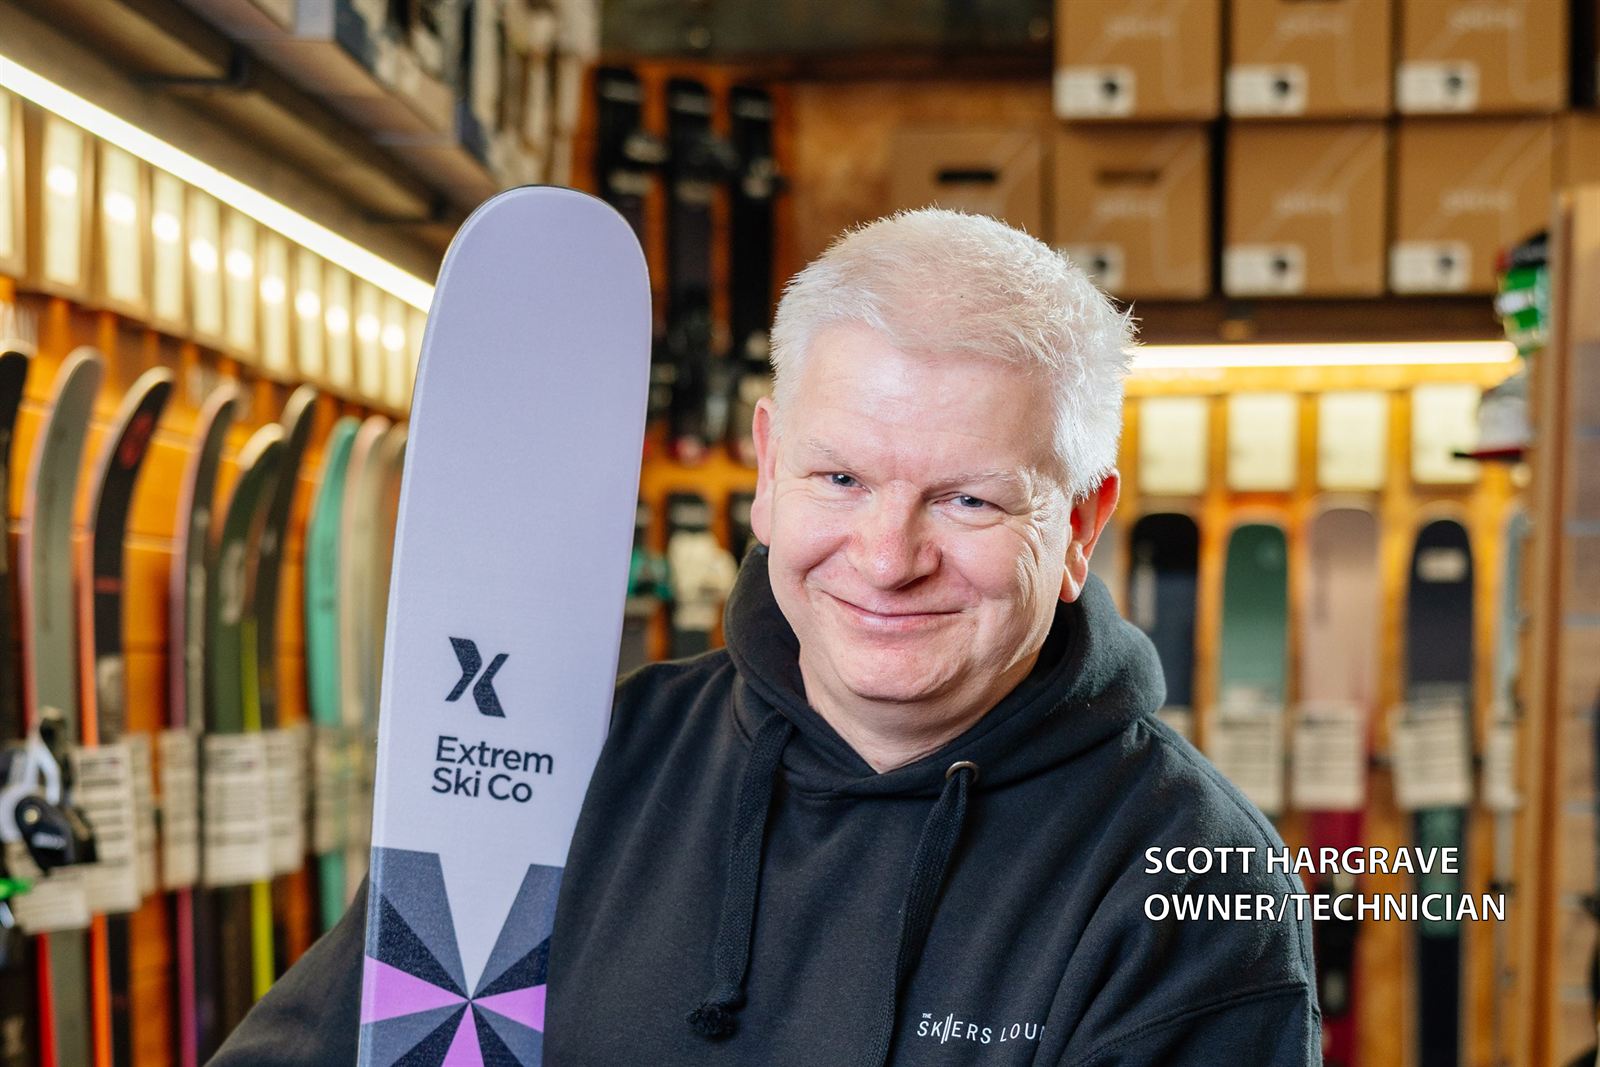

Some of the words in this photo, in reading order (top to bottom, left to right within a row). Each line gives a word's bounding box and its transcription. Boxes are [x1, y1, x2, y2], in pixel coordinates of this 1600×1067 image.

[435, 735, 554, 775] Extrem
[431, 767, 481, 798] Ski
[488, 774, 533, 803] Co
